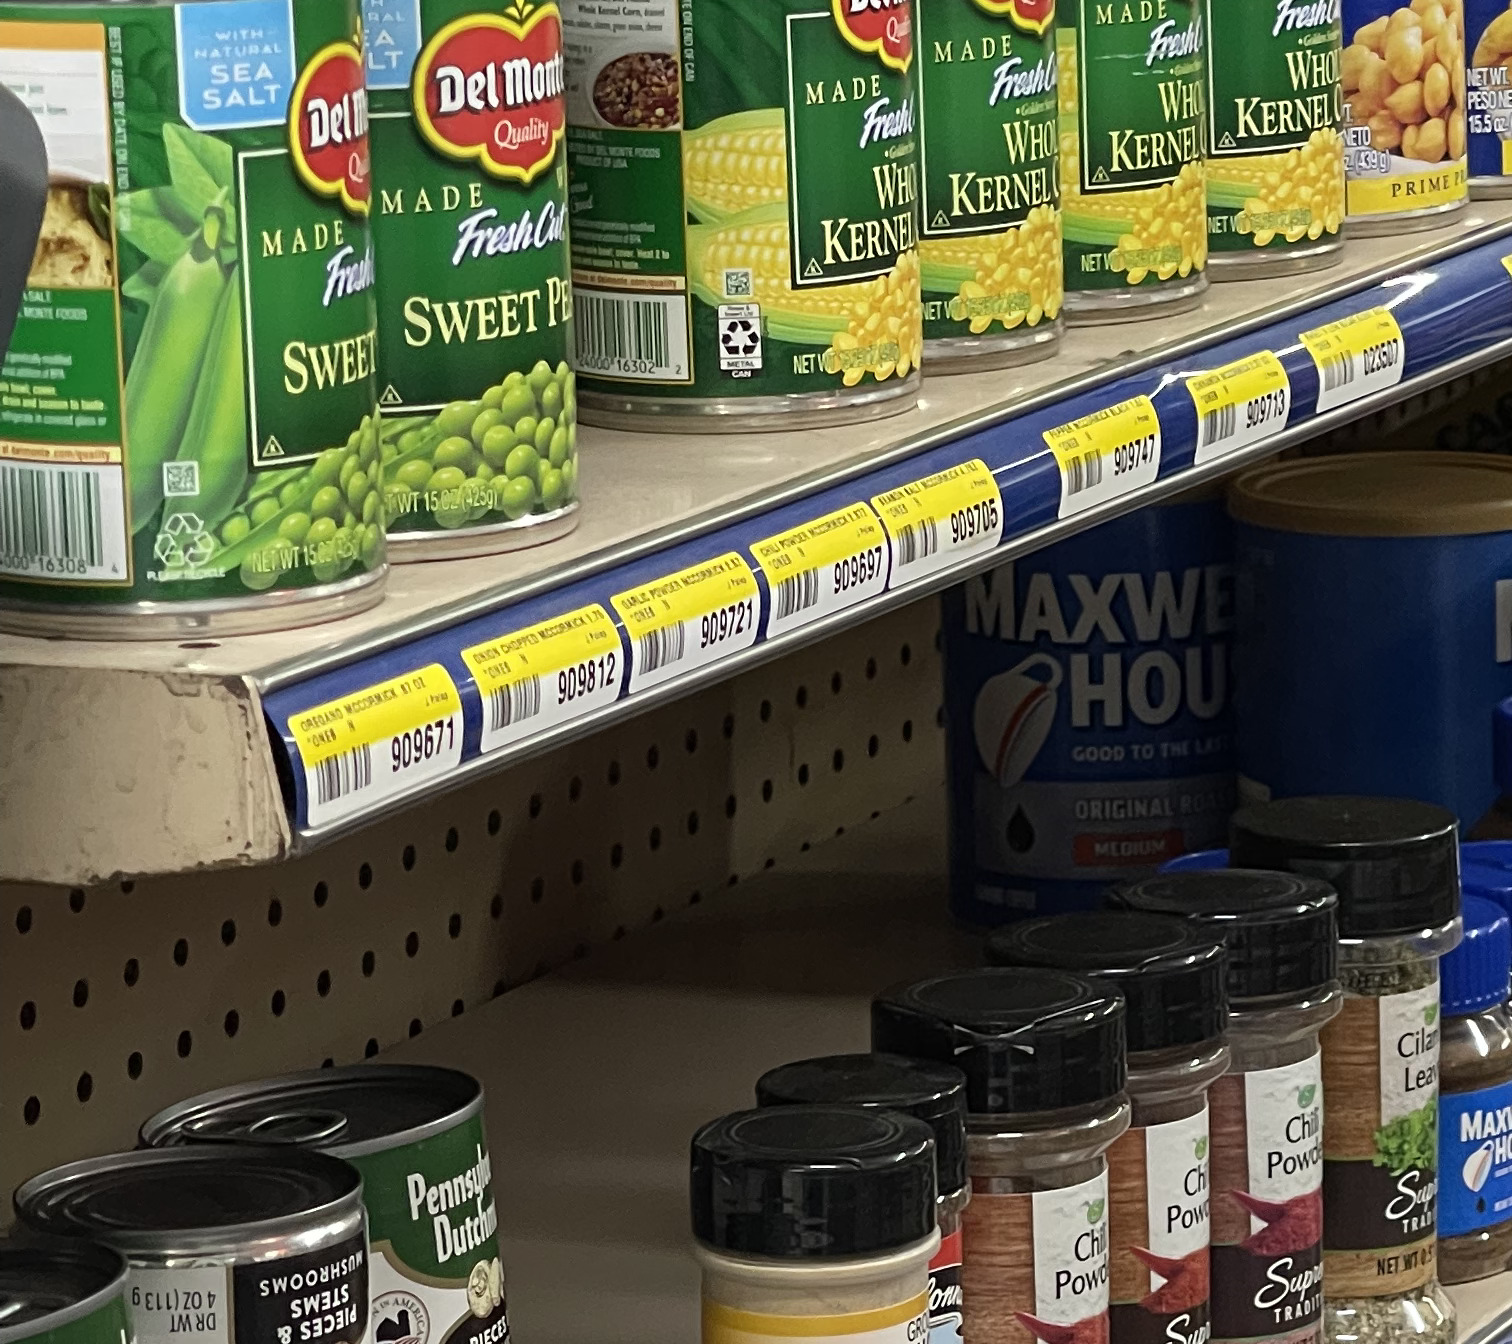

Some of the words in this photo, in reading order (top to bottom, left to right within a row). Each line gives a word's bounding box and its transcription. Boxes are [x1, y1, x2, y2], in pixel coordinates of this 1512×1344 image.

[1096, 0, 1167, 26] MADE
[193, 42, 282, 58] NATURAL
[215, 28, 266, 42] WITH
[934, 35, 1012, 62] MADE
[210, 60, 272, 85] SEA
[440, 63, 495, 112] Del
[203, 86, 282, 108] SALT
[806, 74, 881, 106] MADE
[1468, 91, 1494, 110] PESO
[1235, 95, 1332, 137] KERNEL
[493, 120, 549, 150] Quality
[1109, 131, 1200, 173] KERNEL
[382, 182, 483, 214] MADE
[950, 171, 1048, 219] KERNEL
[1392, 176, 1449, 198] PRIME
[264, 220, 344, 256] MADE
[823, 212, 916, 266] KERNEL
[405, 292, 540, 349] SWEET
[284, 339, 376, 395] SWEET
[616, 359, 655, 375] 16302
[1246, 389, 1285, 429] 909713
[1114, 434, 1155, 475] 909747
[400, 492, 421, 513] WT
[424, 491, 438, 511] 15
[951, 498, 998, 543] 909705
[40, 559, 85, 574] 16308
[834, 546, 882, 594] 909697
[701, 598, 753, 649] 909721
[558, 652, 616, 705] 909812
[1069, 652, 1226, 728] HOU
[392, 717, 455, 772] 909671
[1075, 798, 1172, 821] ORIGINAL
[291, 1284, 349, 1317] STEMS
[301, 1307, 357, 1339] PIECES
